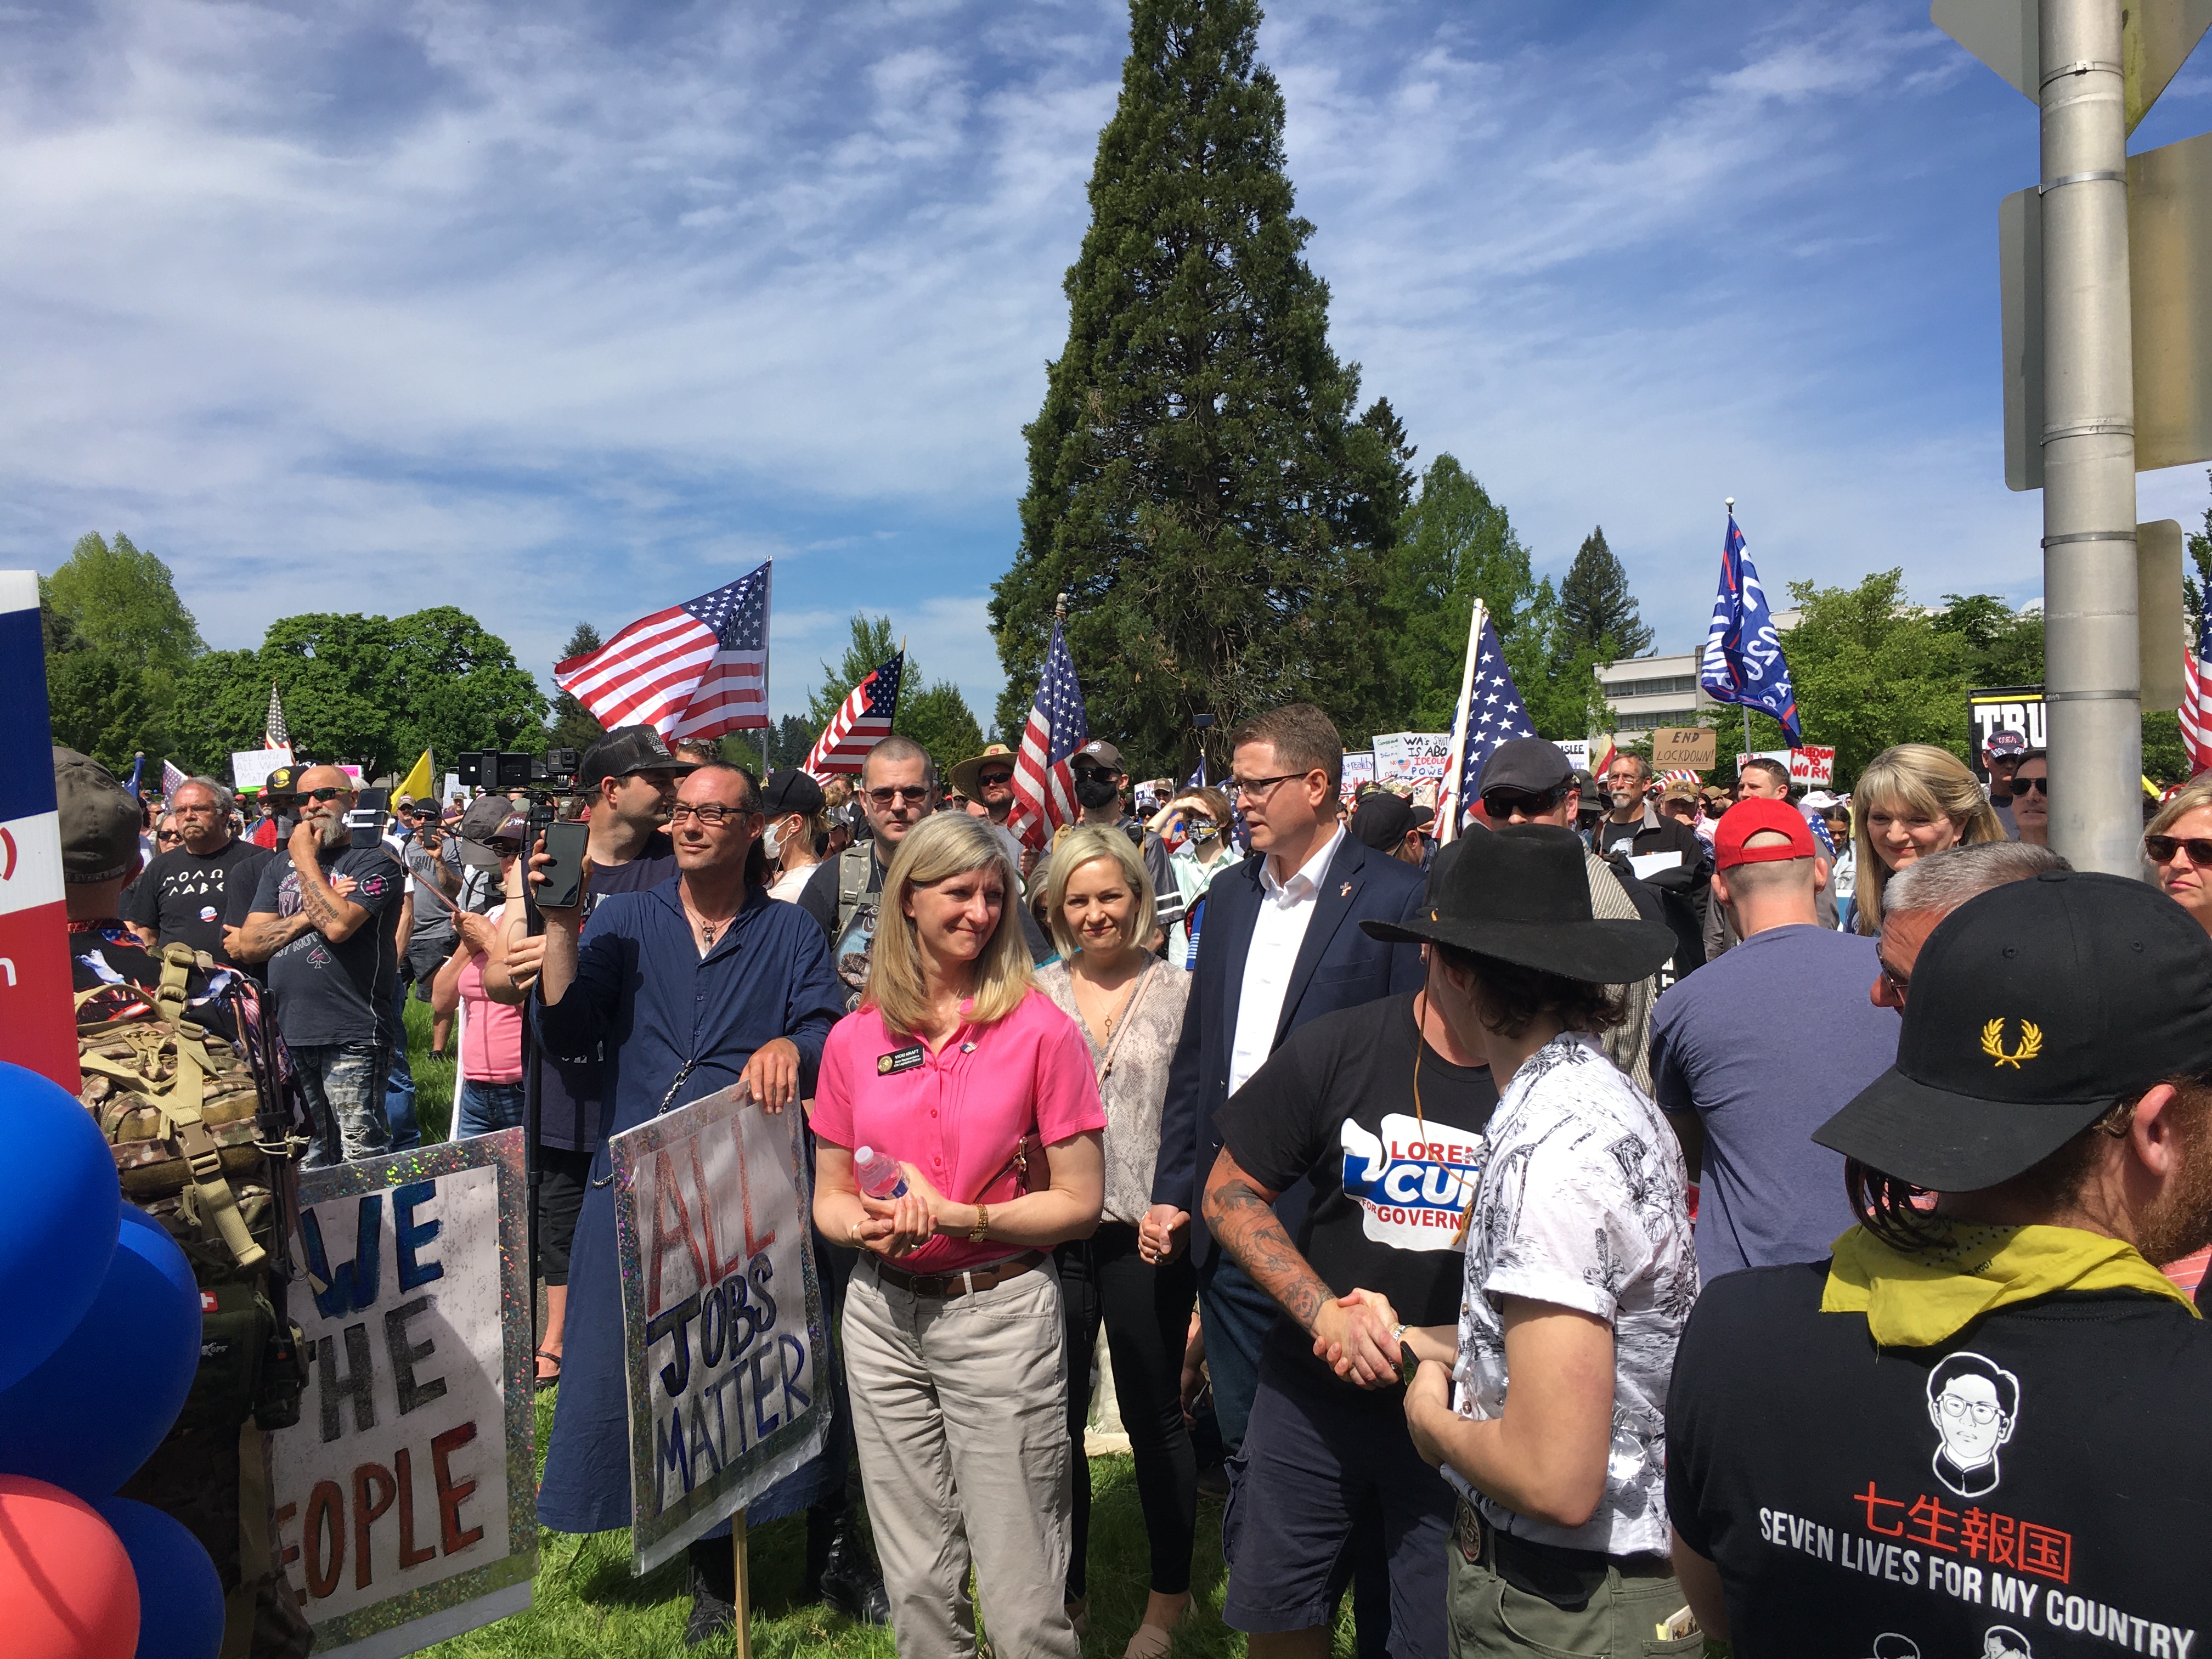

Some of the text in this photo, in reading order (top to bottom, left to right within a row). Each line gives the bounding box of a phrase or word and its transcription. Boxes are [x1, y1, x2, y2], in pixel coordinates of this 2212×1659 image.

[236, 762, 253, 771] ALL
[1408, 747, 1421, 757] IS
[1656, 749, 1714, 762] LOCKDOWN!
[1672, 732, 1700, 743] END
[1810, 758, 1821, 766] TO
[1791, 763, 1830, 781] WORK
[648, 1114, 776, 1317] ALL
[1362, 1198, 1377, 1215] FOR
[301, 1179, 445, 1319] WE
[647, 1252, 777, 1398] JOBS
[305, 1294, 448, 1443] HE
[658, 1334, 811, 1514] MATTER
[1854, 1481, 2072, 1584] 七生報国
[1759, 1507, 2195, 1659] SEVEN LIVES FOR MY COUNTRY
